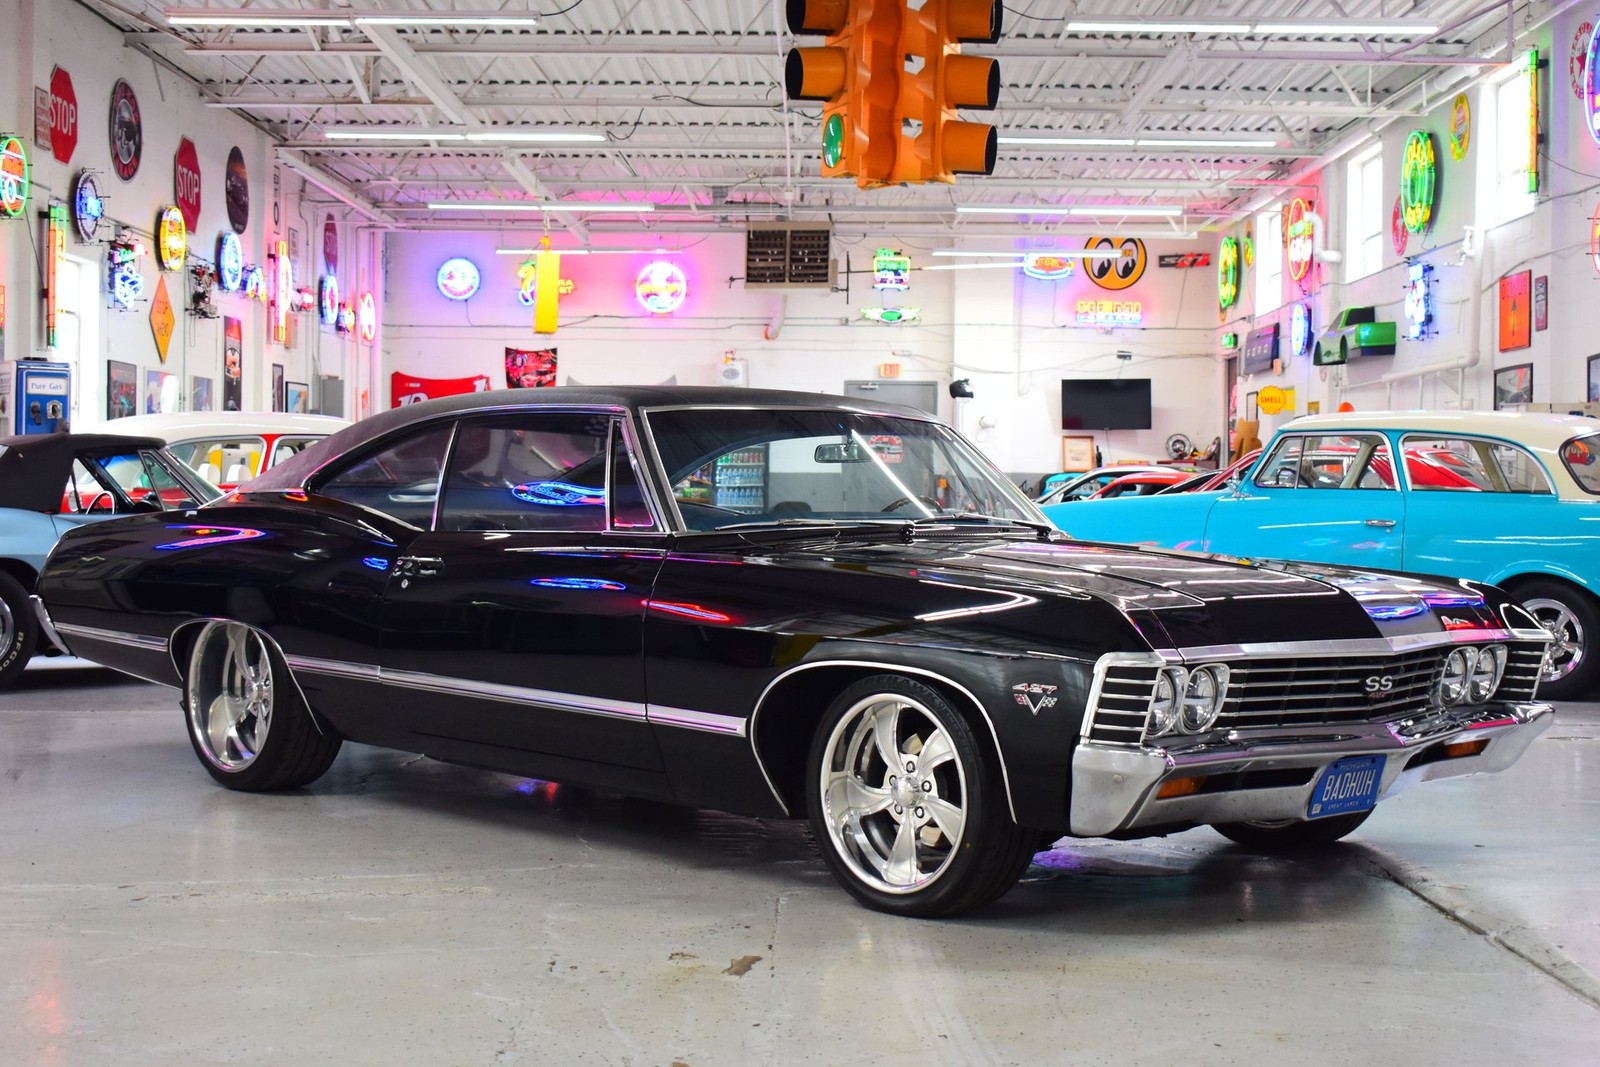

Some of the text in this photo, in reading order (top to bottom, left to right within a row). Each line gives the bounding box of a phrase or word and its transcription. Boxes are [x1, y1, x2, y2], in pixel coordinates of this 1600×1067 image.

[50, 94, 76, 137] STOP
[177, 165, 200, 206] STOP
[883, 363, 900, 377] EXIT
[31, 382, 47, 390] Pure
[1260, 396, 1282, 404] SHELL
[1012, 682, 1058, 695] 427
[1364, 675, 1393, 691] SS
[1339, 762, 1370, 770] MICHIGAN
[1321, 769, 1377, 802] BADHUH
